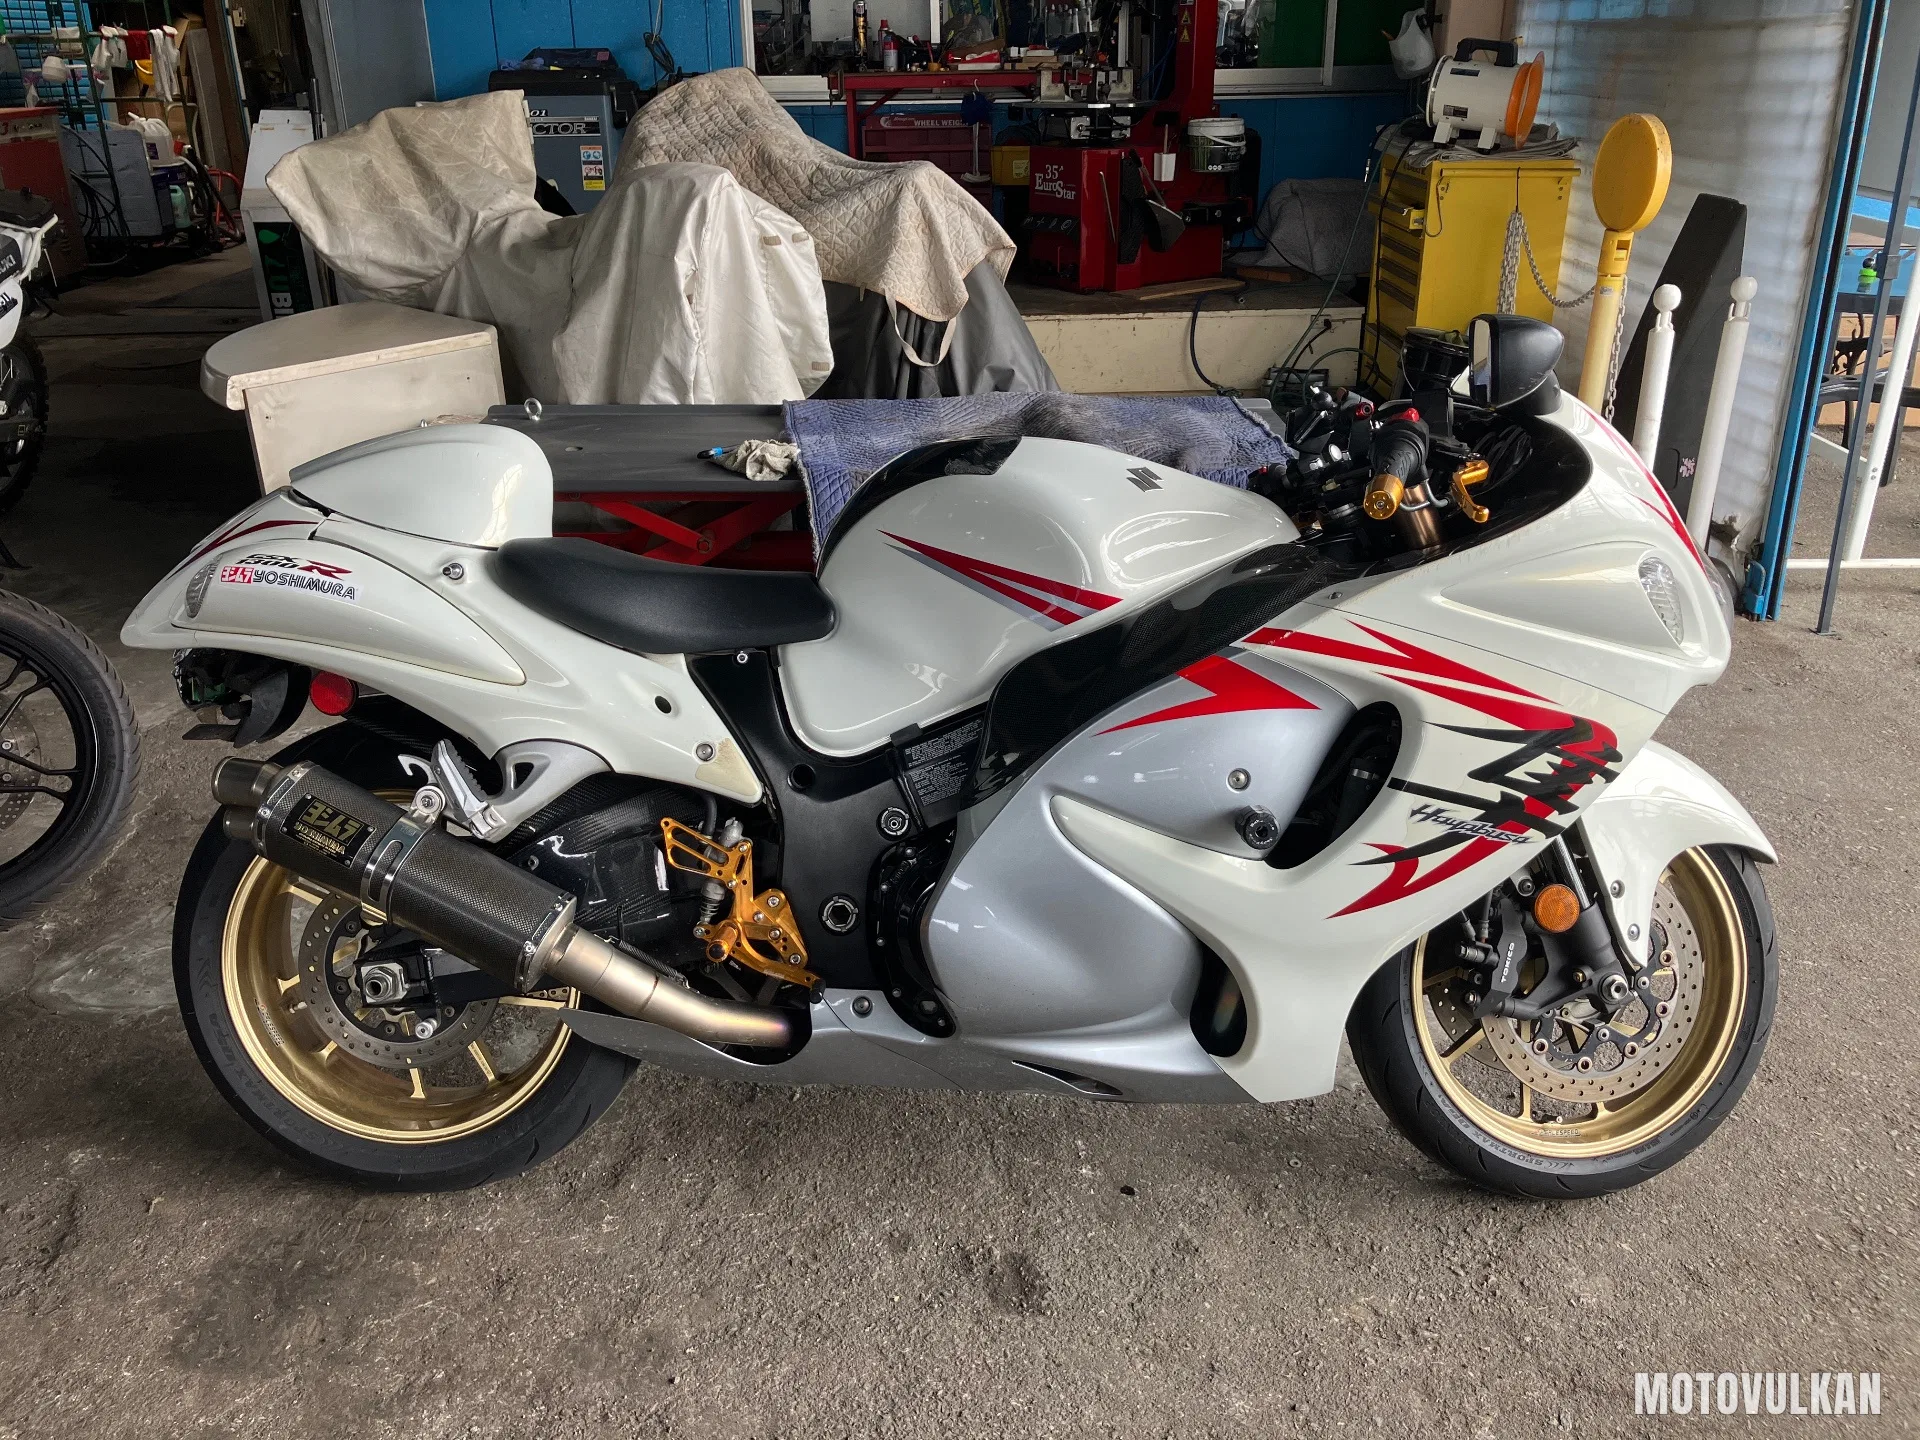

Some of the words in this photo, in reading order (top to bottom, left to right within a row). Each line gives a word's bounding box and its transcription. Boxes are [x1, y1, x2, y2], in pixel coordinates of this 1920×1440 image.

[914, 119, 940, 127] WHEEL
[1034, 173, 1077, 200] EuroStar
[253, 569, 356, 601] YOSHIMURA
[301, 800, 361, 842] ヨシムラ
[1408, 803, 1536, 845] Hayabusa
[1500, 942, 1515, 983] TOKICO
[1472, 1131, 1543, 1167] SPORTMAX
